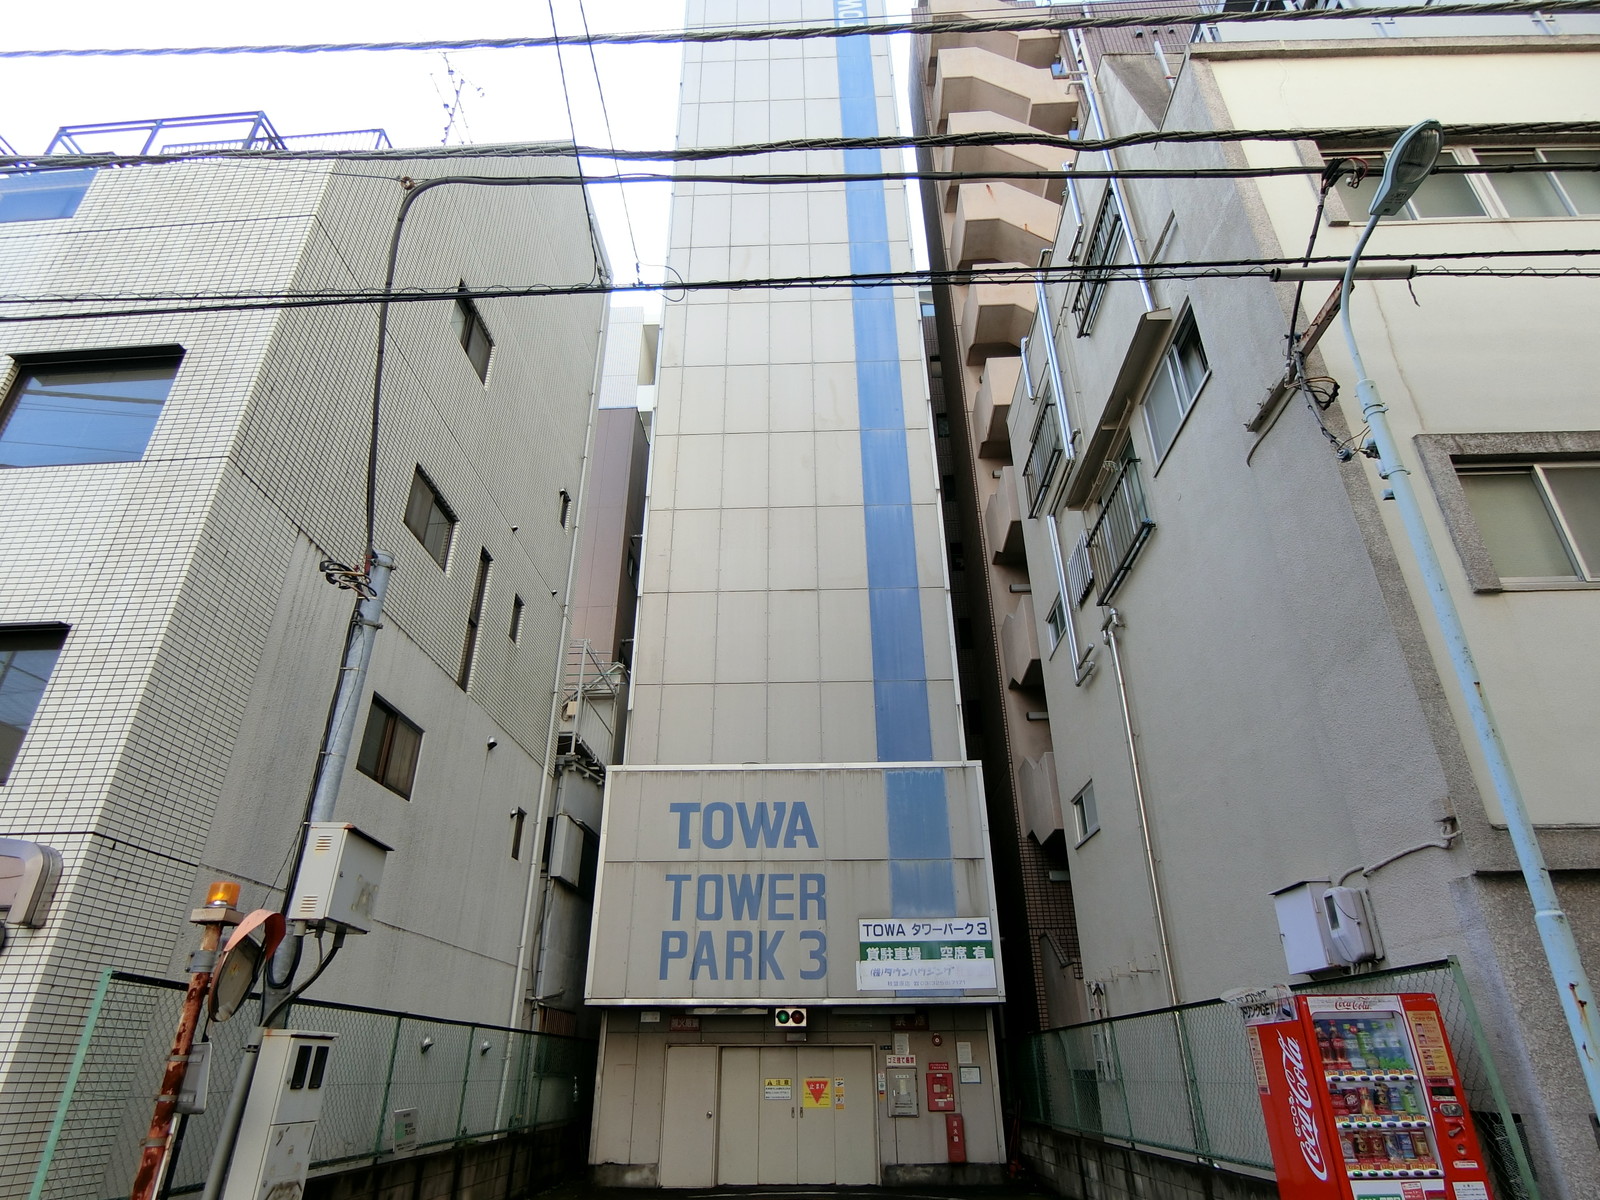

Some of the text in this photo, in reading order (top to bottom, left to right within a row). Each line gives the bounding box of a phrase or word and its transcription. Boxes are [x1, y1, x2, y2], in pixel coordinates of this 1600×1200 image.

[669, 801, 819, 850] TOWA
[665, 873, 827, 922] TOWER
[862, 923, 906, 937] TOWA
[659, 930, 828, 981] PARK 3
[1276, 1028, 1328, 1181] Coca-Cola
